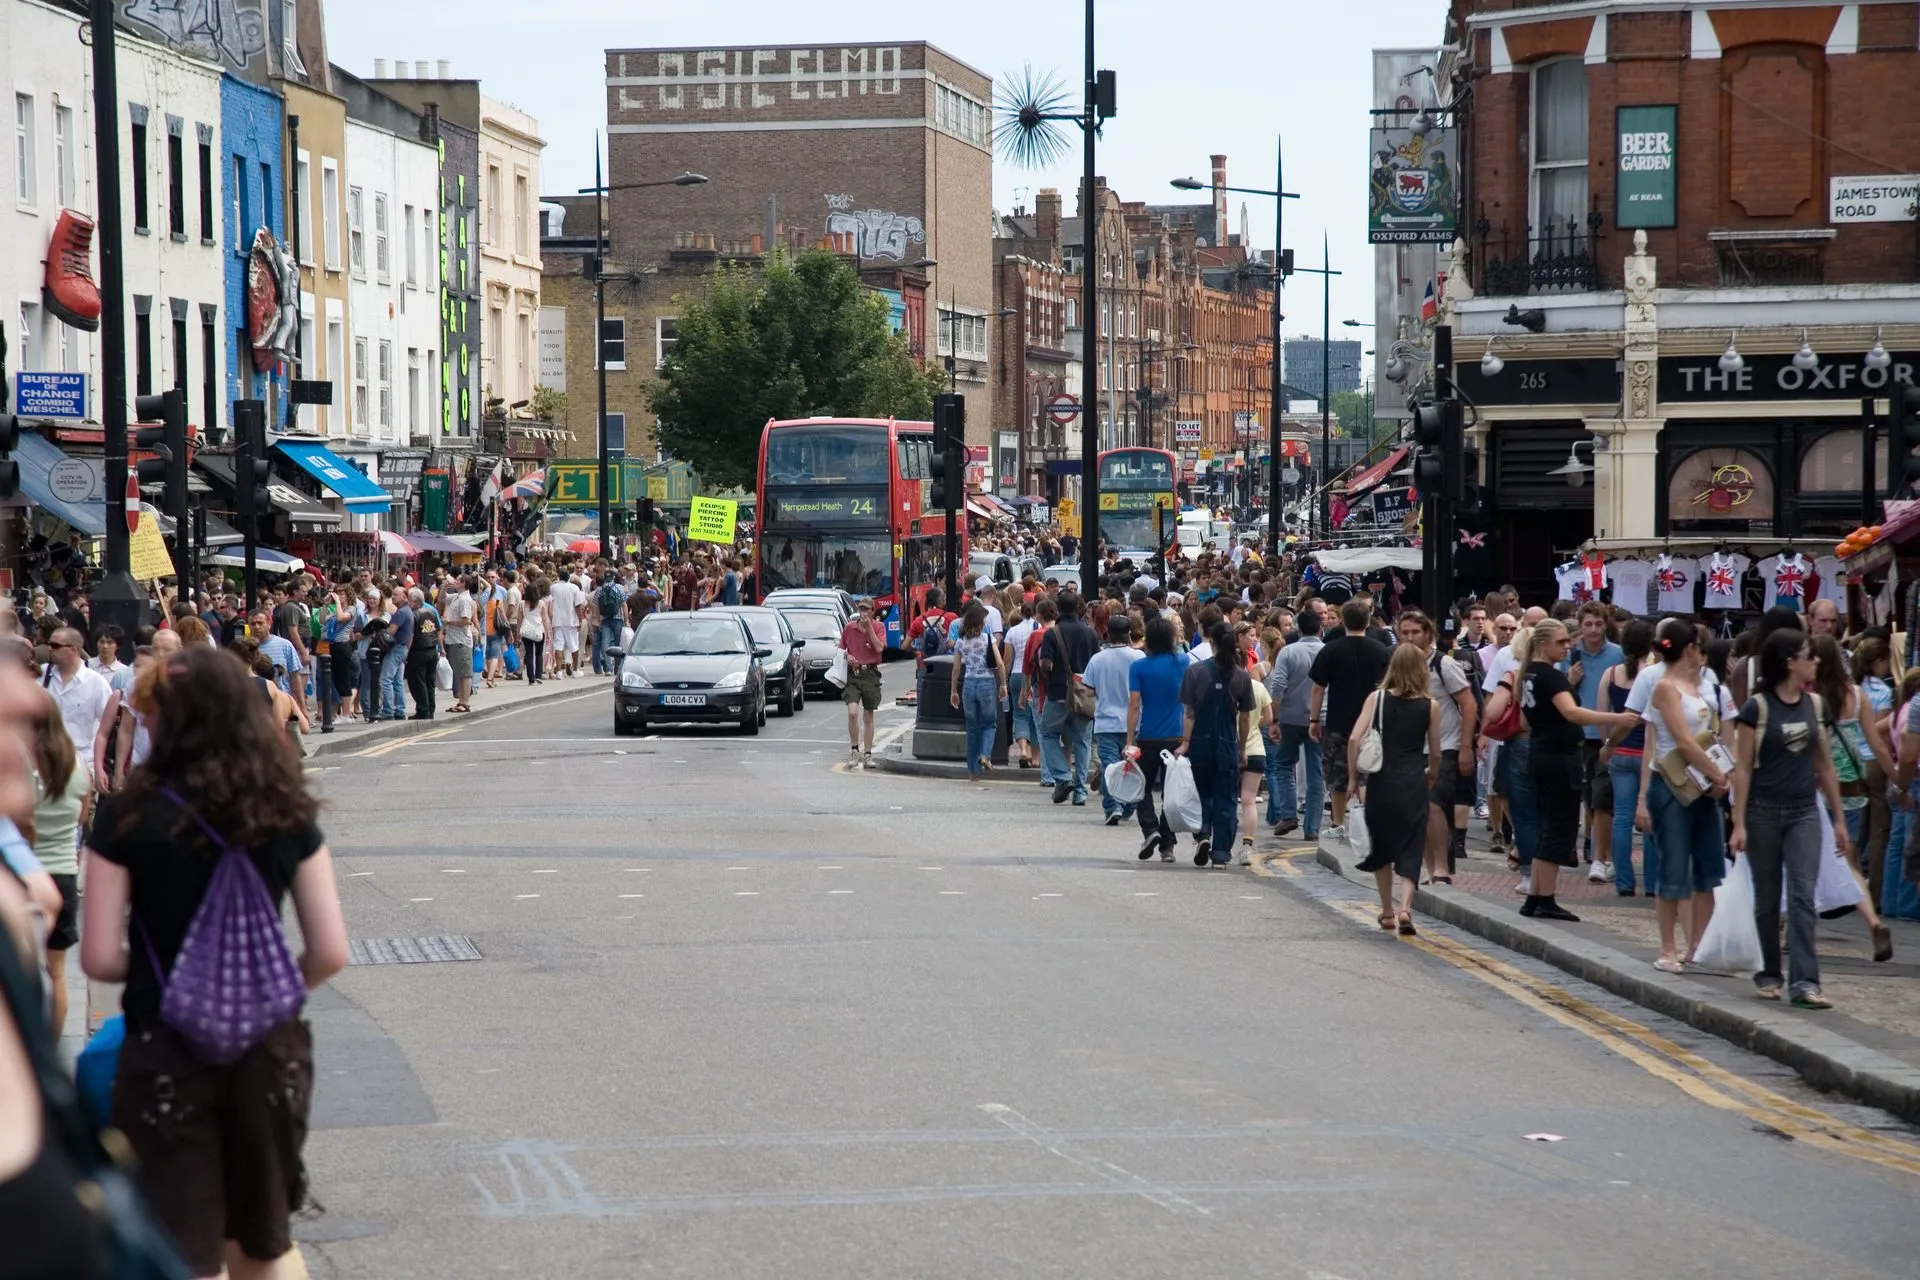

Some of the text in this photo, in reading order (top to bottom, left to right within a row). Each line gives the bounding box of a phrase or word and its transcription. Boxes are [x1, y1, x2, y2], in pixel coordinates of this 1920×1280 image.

[619, 47, 900, 110] LOGIC ELMO
[1621, 132, 1672, 154] BEER
[1621, 154, 1671, 171] GARDEN
[1835, 186, 1920, 200] JAMESTOWN
[1835, 205, 1876, 217] ROAD
[1372, 232, 1452, 240] OXFORD ARMS
[458, 174, 468, 421] TATTOO
[22, 375, 80, 385] BUREAU
[1520, 372, 1546, 389] 265
[1679, 366, 1752, 392] THE
[21, 389, 80, 399] CHANGE
[27, 398, 74, 407] COMBIO
[22, 405, 79, 414] WESCHEL
[700, 502, 726, 510] ECLIPSE
[781, 499, 873, 515] Hampstead Heath 24
[697, 508, 728, 517] PIERCING
[699, 515, 725, 523] TATTOO
[688, 695, 704, 704] CVX
